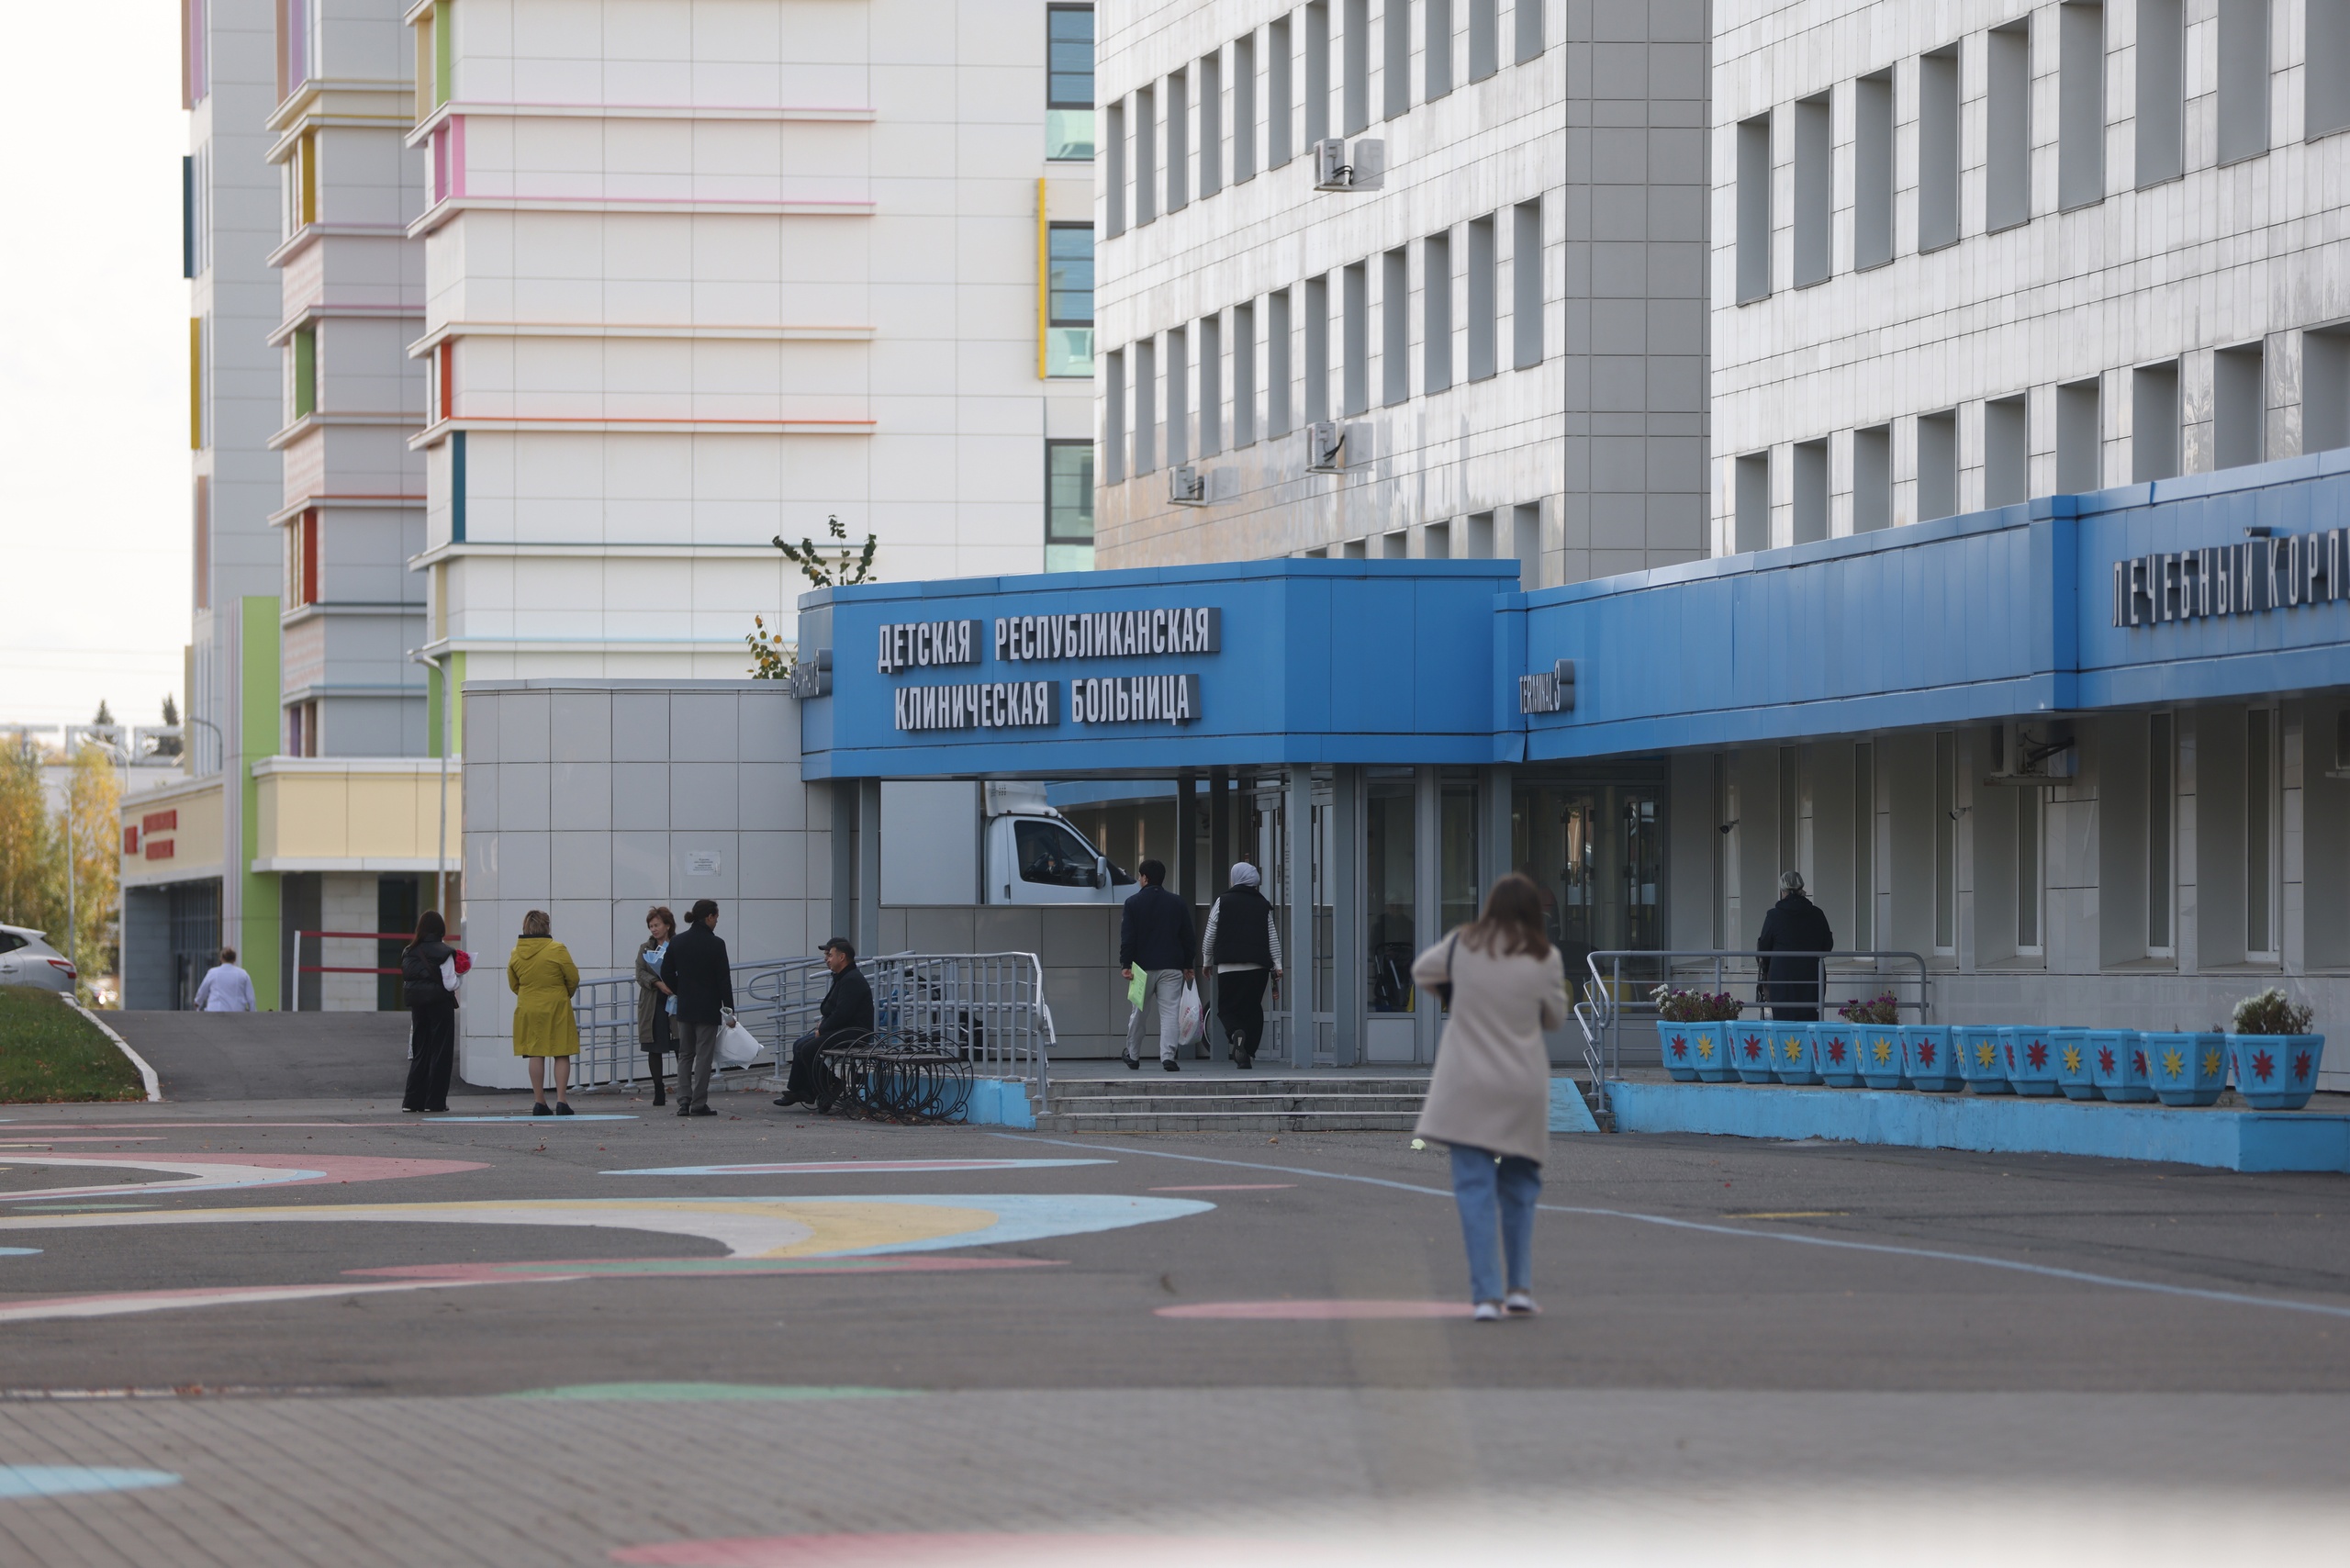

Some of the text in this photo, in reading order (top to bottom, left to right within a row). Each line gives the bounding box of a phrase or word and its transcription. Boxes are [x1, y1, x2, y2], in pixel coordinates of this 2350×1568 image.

[2113, 526, 2350, 627] ЛЕЧЕБНЫЙ КОРП
[878, 607, 1209, 674] ДЕТСКАЯ РЕСПУБЛИКАНСКАЯ
[895, 674, 1190, 730] КЛИНИЧЕСКАЯ БОЛЬНИЦА
[1518, 672, 1553, 714] TERMINAL
